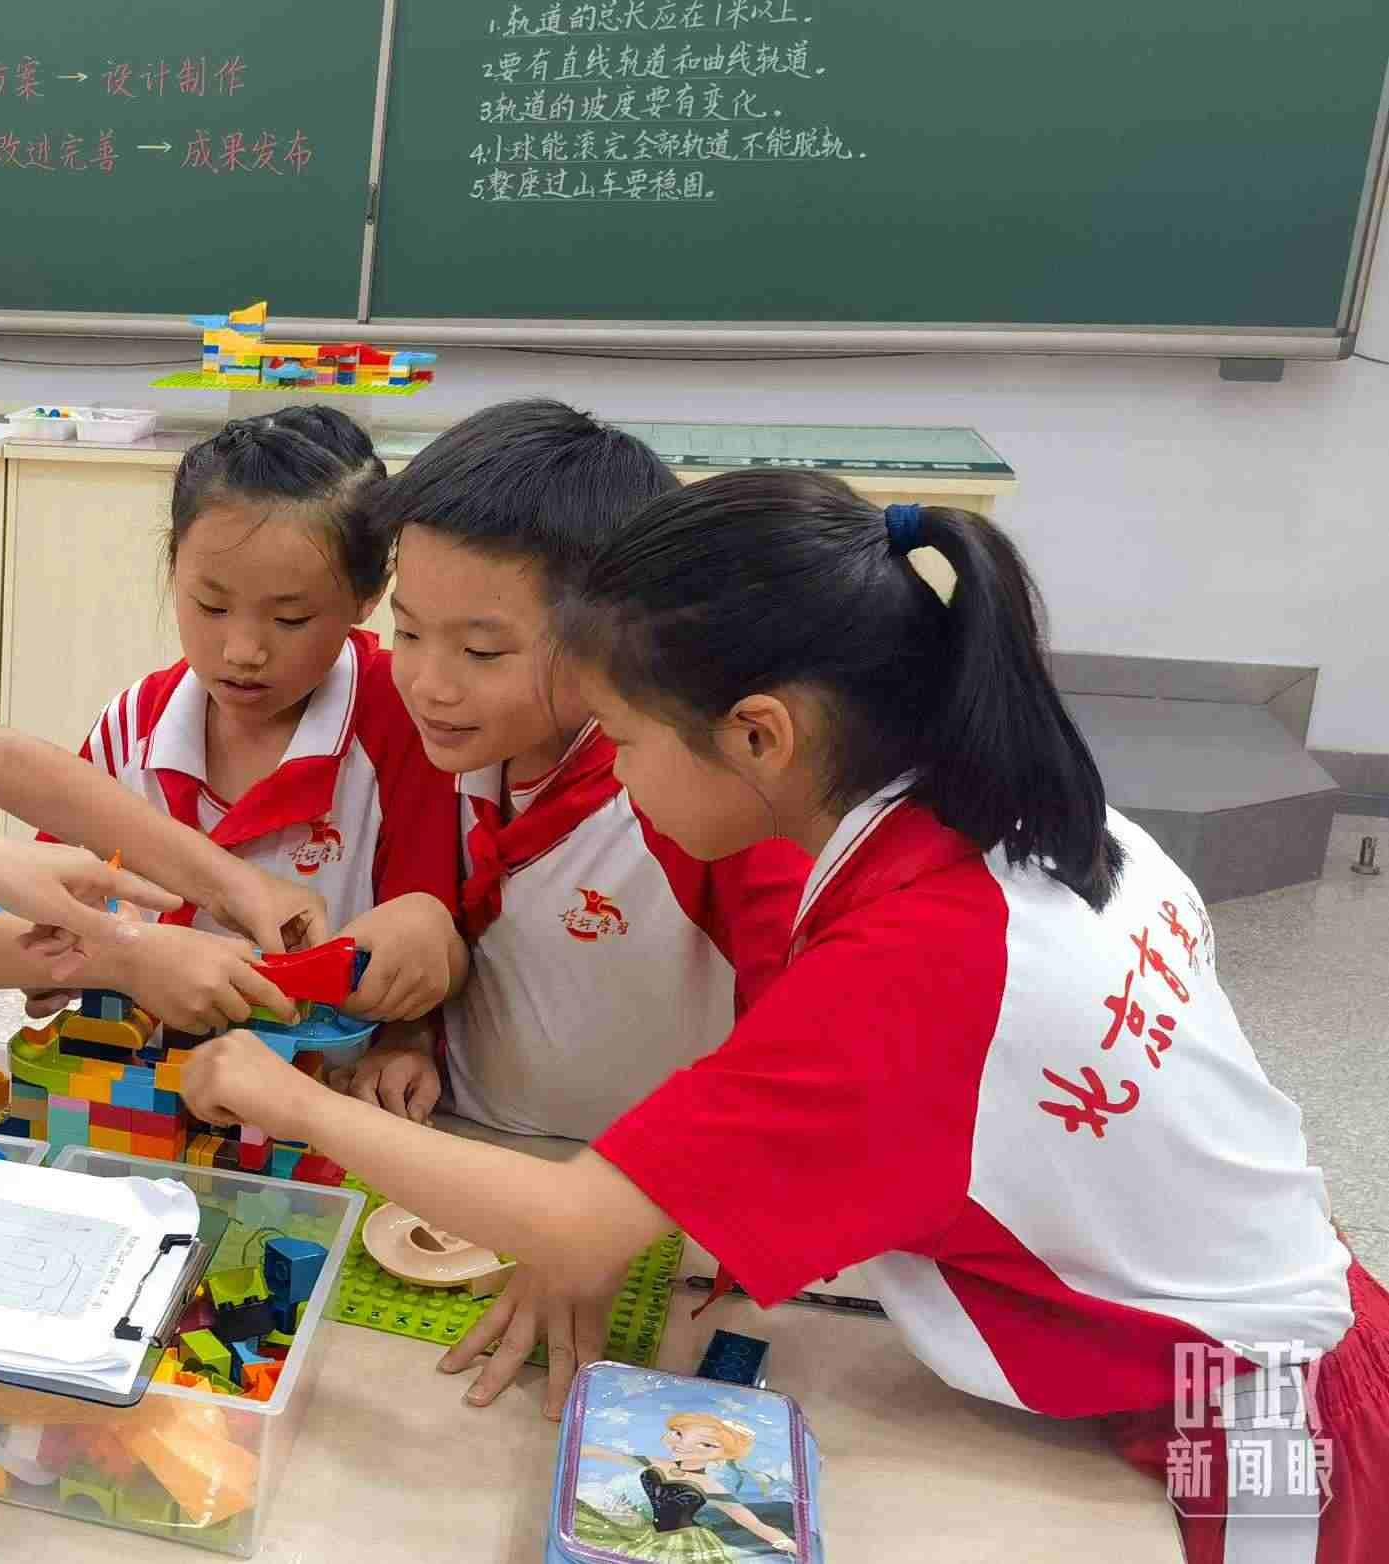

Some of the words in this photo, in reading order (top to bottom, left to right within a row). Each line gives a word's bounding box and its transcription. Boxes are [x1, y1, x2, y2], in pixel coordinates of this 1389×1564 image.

[102, 55, 250, 99] 设计制作
[180, 128, 315, 175] 成果发布
